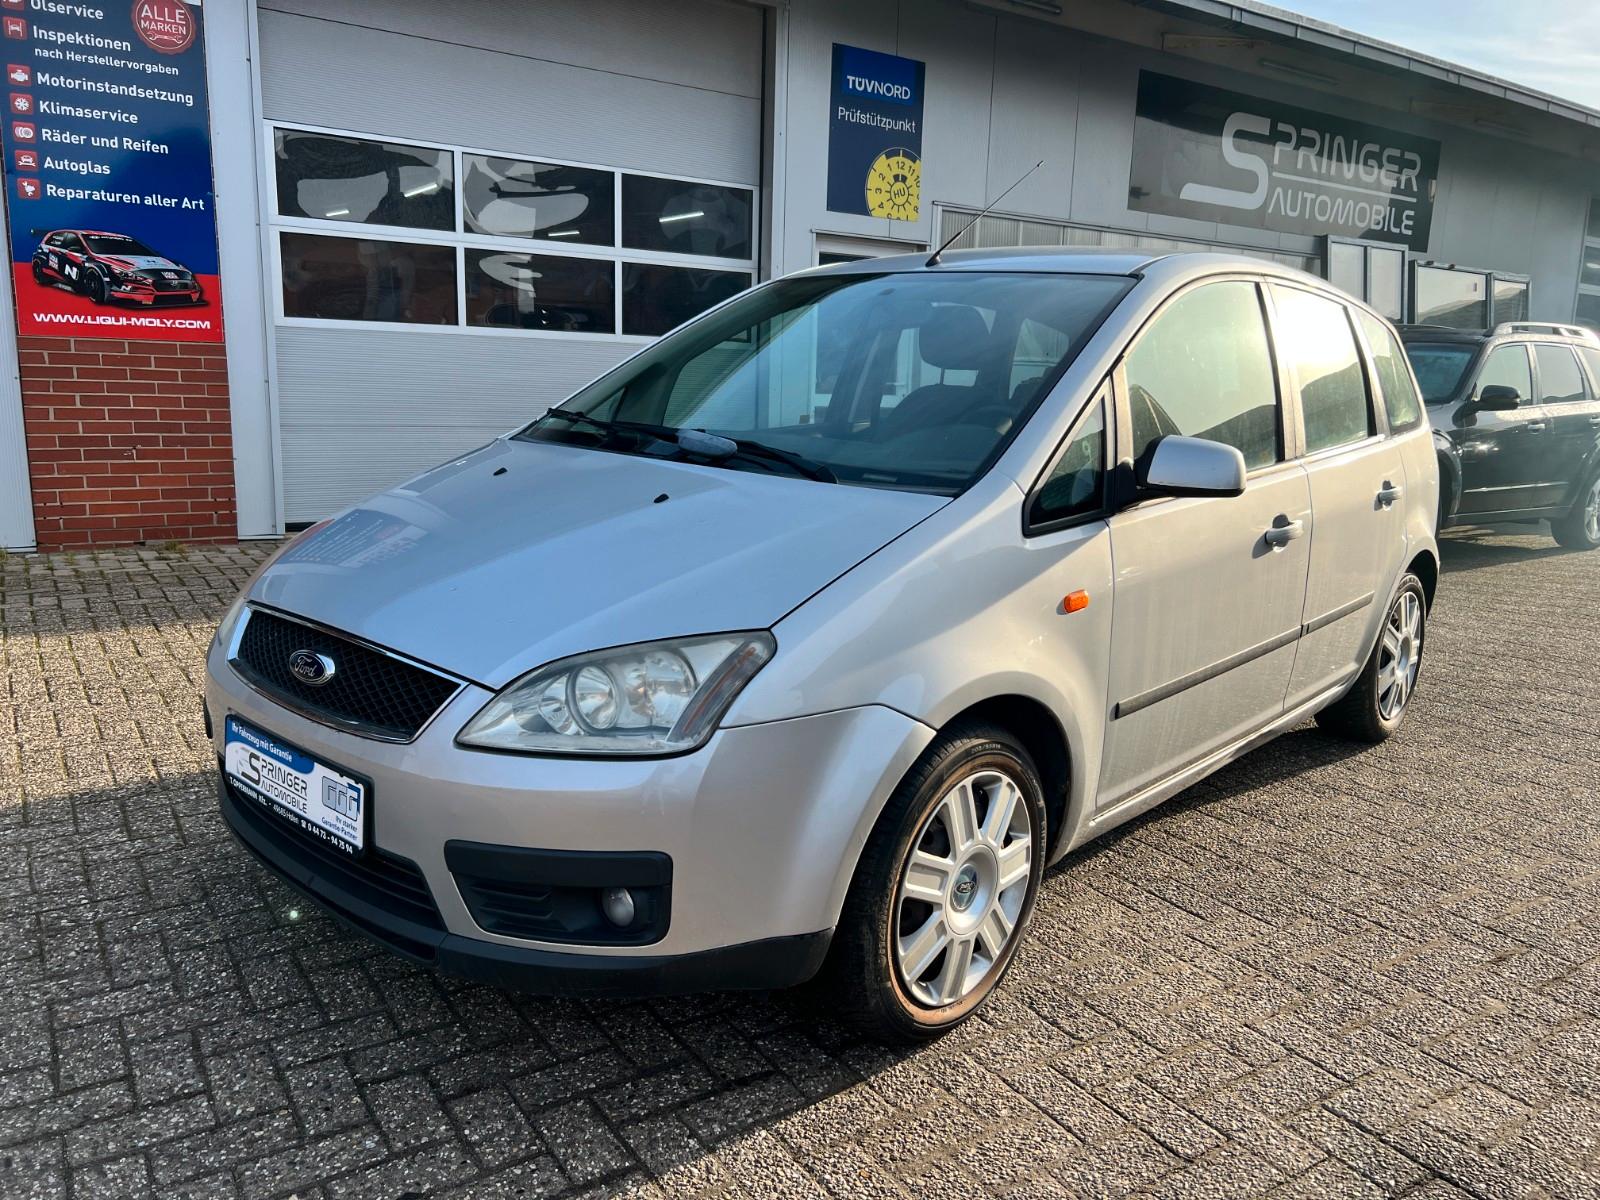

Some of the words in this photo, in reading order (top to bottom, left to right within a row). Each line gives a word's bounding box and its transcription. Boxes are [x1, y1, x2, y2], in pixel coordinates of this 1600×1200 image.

[141, 4, 186, 25] ALLE
[33, 25, 131, 51] Inspektionen
[140, 20, 187, 35] MARKEN
[34, 47, 63, 60] nach
[66, 51, 179, 76] Herstellervorgaben
[37, 71, 194, 107] Motorinstandsetzung
[39, 100, 139, 124] Klimaservice
[838, 106, 916, 134] Prüfstützpunkt
[41, 128, 87, 147] Räder
[91, 133, 119, 149] und
[123, 137, 169, 155] Reifen
[43, 157, 111, 175] Autoglas
[896, 160, 905, 170] 12
[908, 165, 915, 176] 11
[1180, 111, 1422, 211] SPRINGER
[878, 173, 886, 181] 2
[46, 184, 141, 205] Reparaturen
[144, 194, 178, 208] aller
[182, 197, 205, 210] Art
[893, 187, 905, 199] HU
[1268, 187, 1415, 236] AUTOMOBILE
[33, 312, 210, 329] WWW.LIQUI-MOLY.COM
[295, 656, 317, 677] Ford
[239, 726, 260, 748] Fahrzeug
[260, 739, 269, 751] mit
[269, 743, 293, 763] Garantie
[241, 751, 308, 797] SPRINGER
[261, 780, 308, 815] AUTOMOBILE
[307, 822, 312, 831] 0
[312, 825, 320, 836] 44
[331, 835, 338, 846] 94
